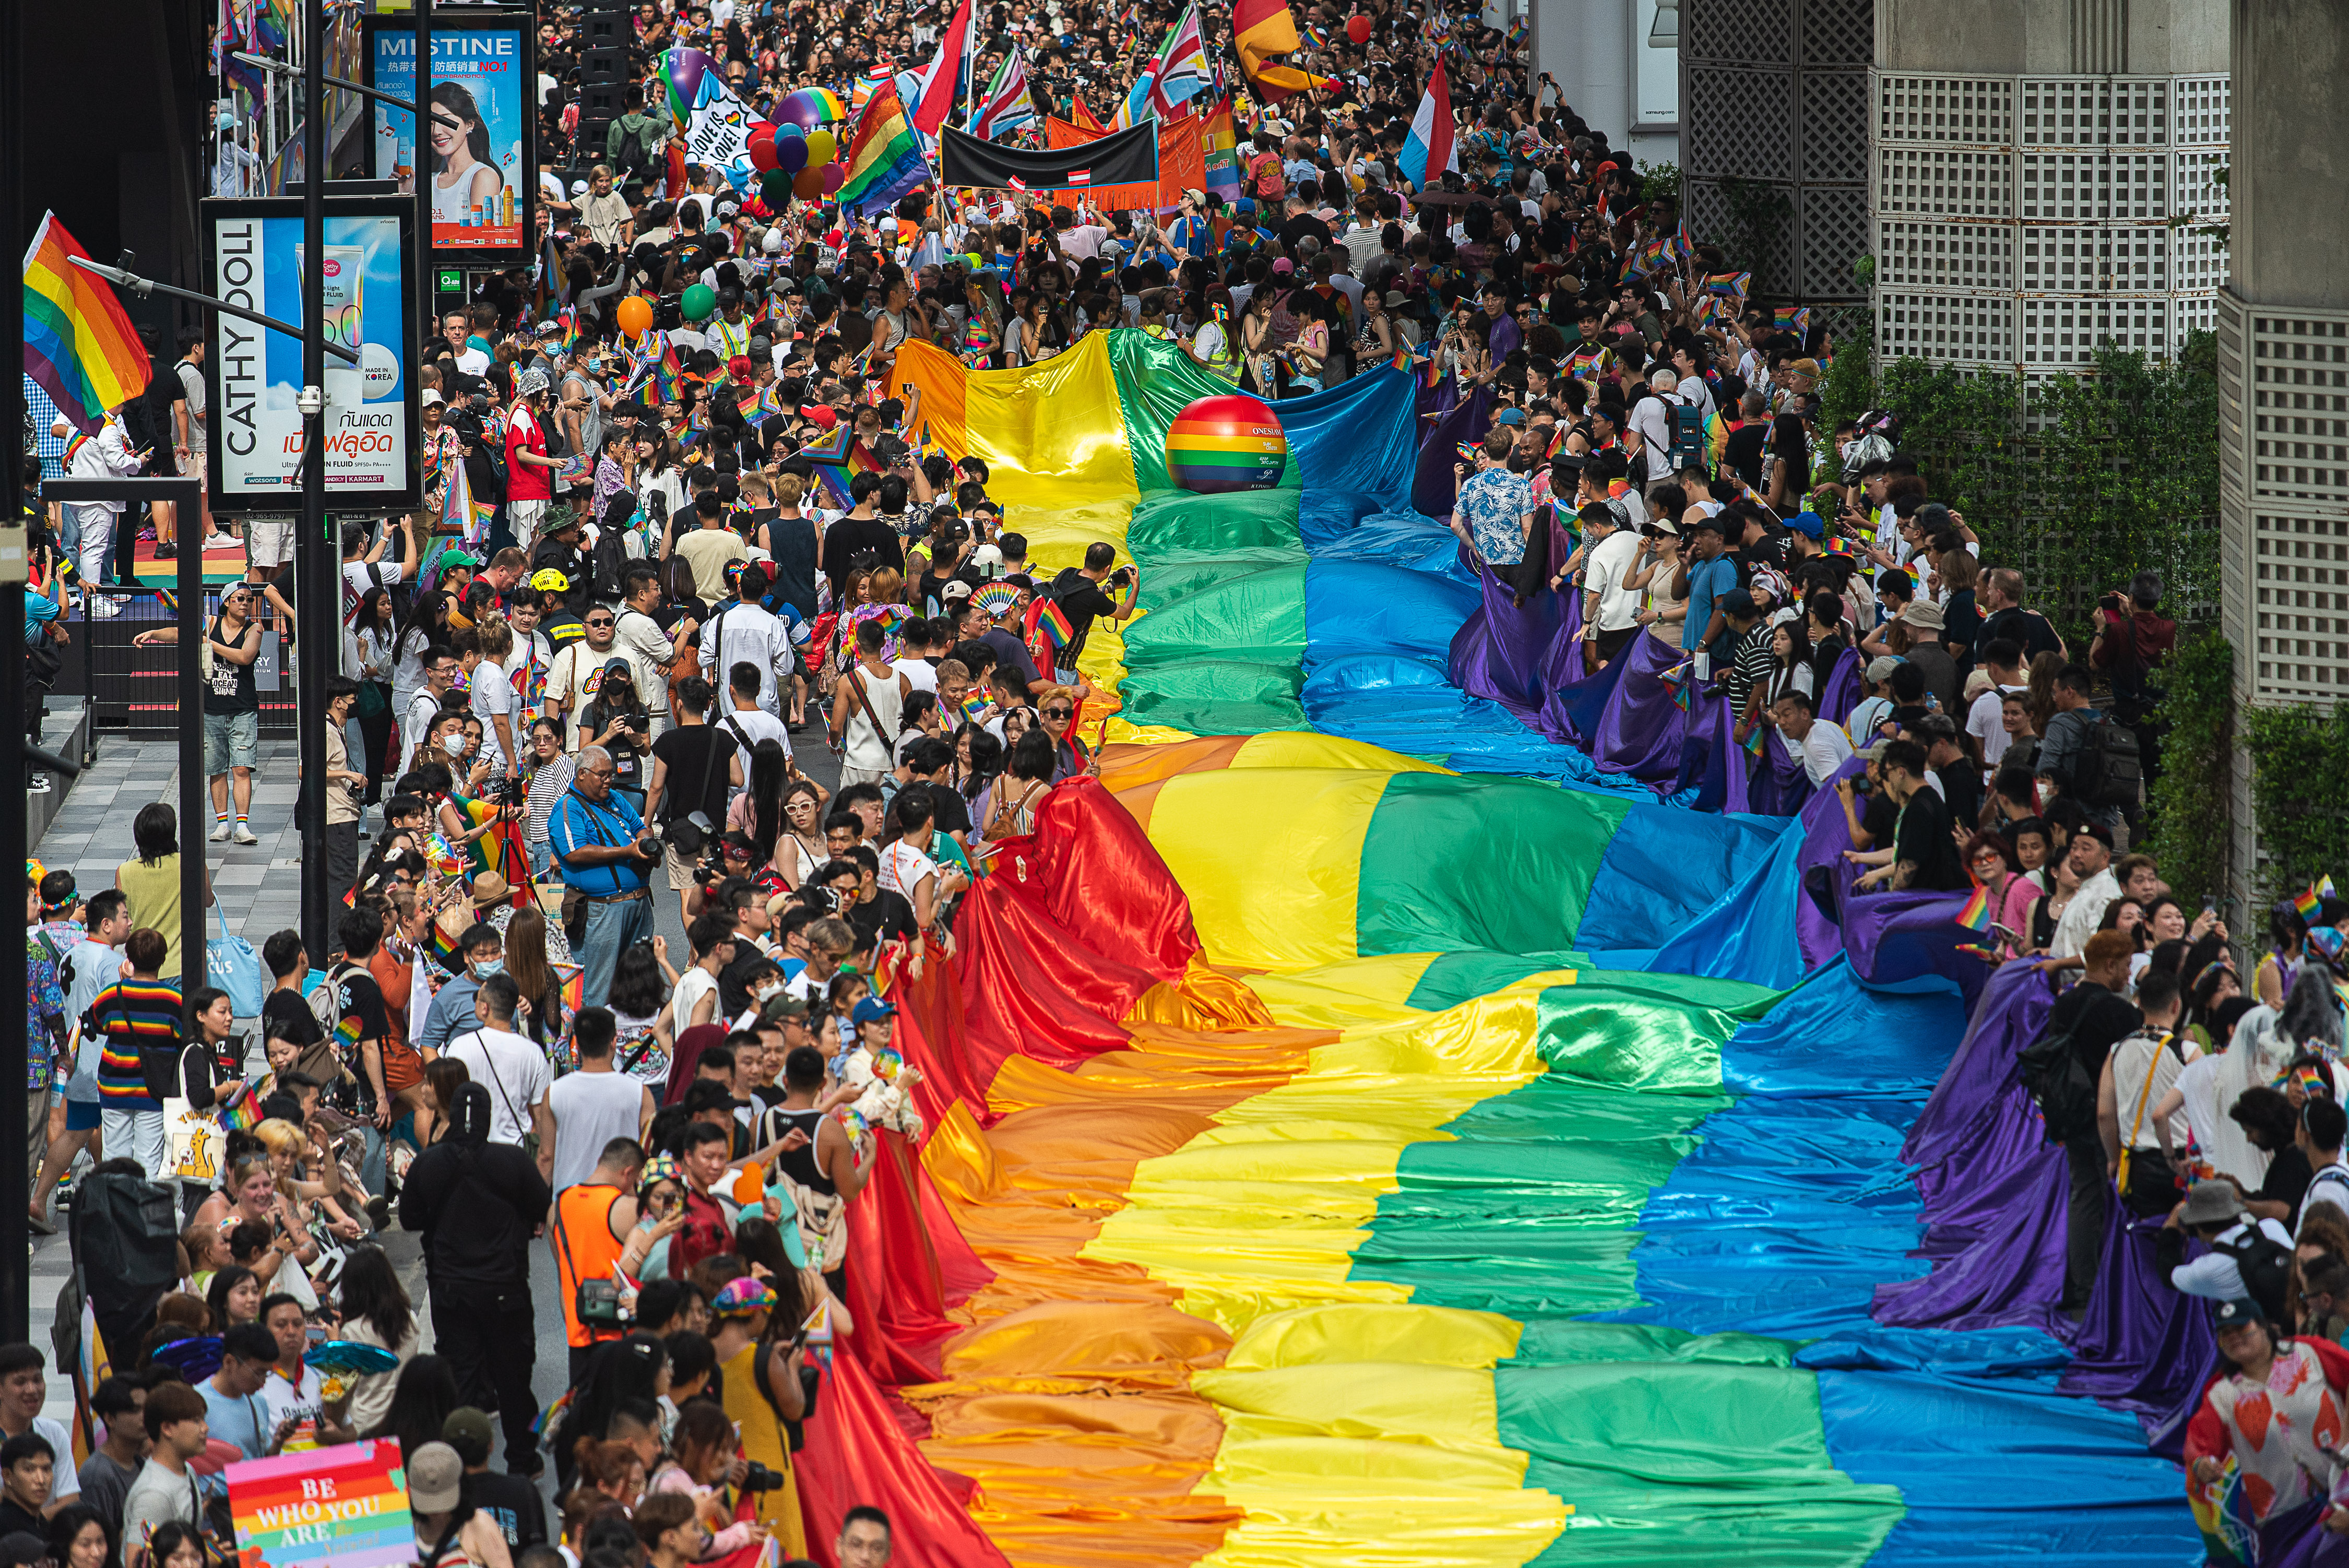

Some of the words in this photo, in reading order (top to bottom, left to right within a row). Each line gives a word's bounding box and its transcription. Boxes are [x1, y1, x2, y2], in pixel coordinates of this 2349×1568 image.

[692, 123, 719, 155] LOVE
[709, 111, 725, 130] IS
[710, 128, 741, 162] LOVE!
[222, 224, 254, 313] DOLL
[224, 325, 256, 456] CATHY
[339, 411, 393, 427] กันแดด
[1252, 427, 1282, 436] ONESIAM
[534, 570, 557, 579] RESCUE
[212, 678, 238, 688] OCEAN
[177, 1110, 219, 1126] YUMMY
[300, 1478, 337, 1500] BE
[255, 1500, 321, 1528] WHO
[325, 1495, 379, 1522] YOU
[281, 1521, 332, 1548] ARE
